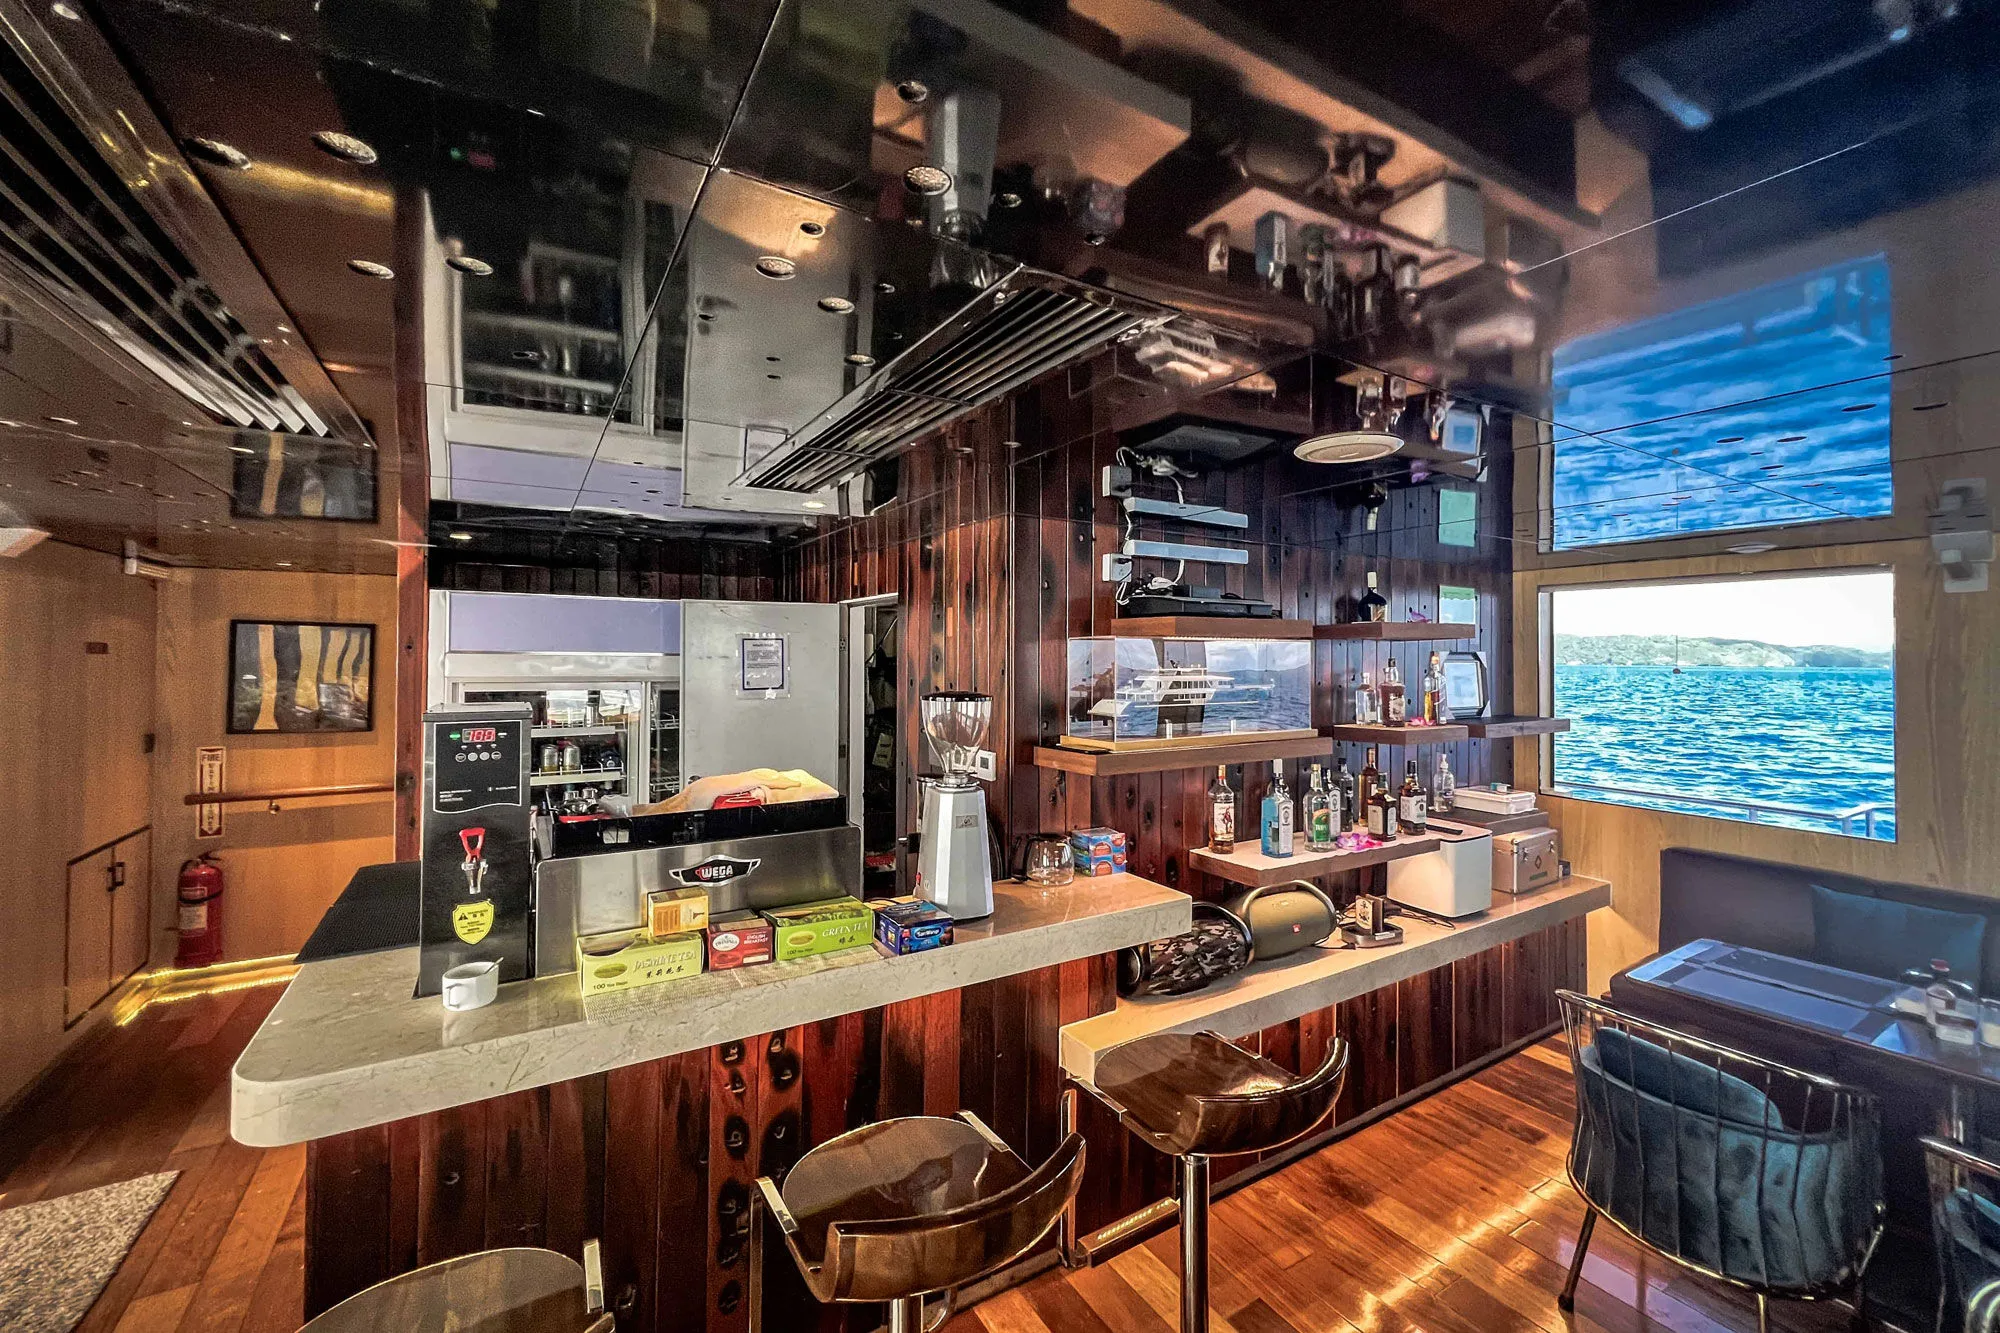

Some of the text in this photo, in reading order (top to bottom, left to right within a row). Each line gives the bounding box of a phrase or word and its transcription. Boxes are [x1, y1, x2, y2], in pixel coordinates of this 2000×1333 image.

[701, 864, 733, 879] WEGA
[822, 921, 868, 937] GREEN TEA
[633, 951, 698, 974] JASMINE TEA
